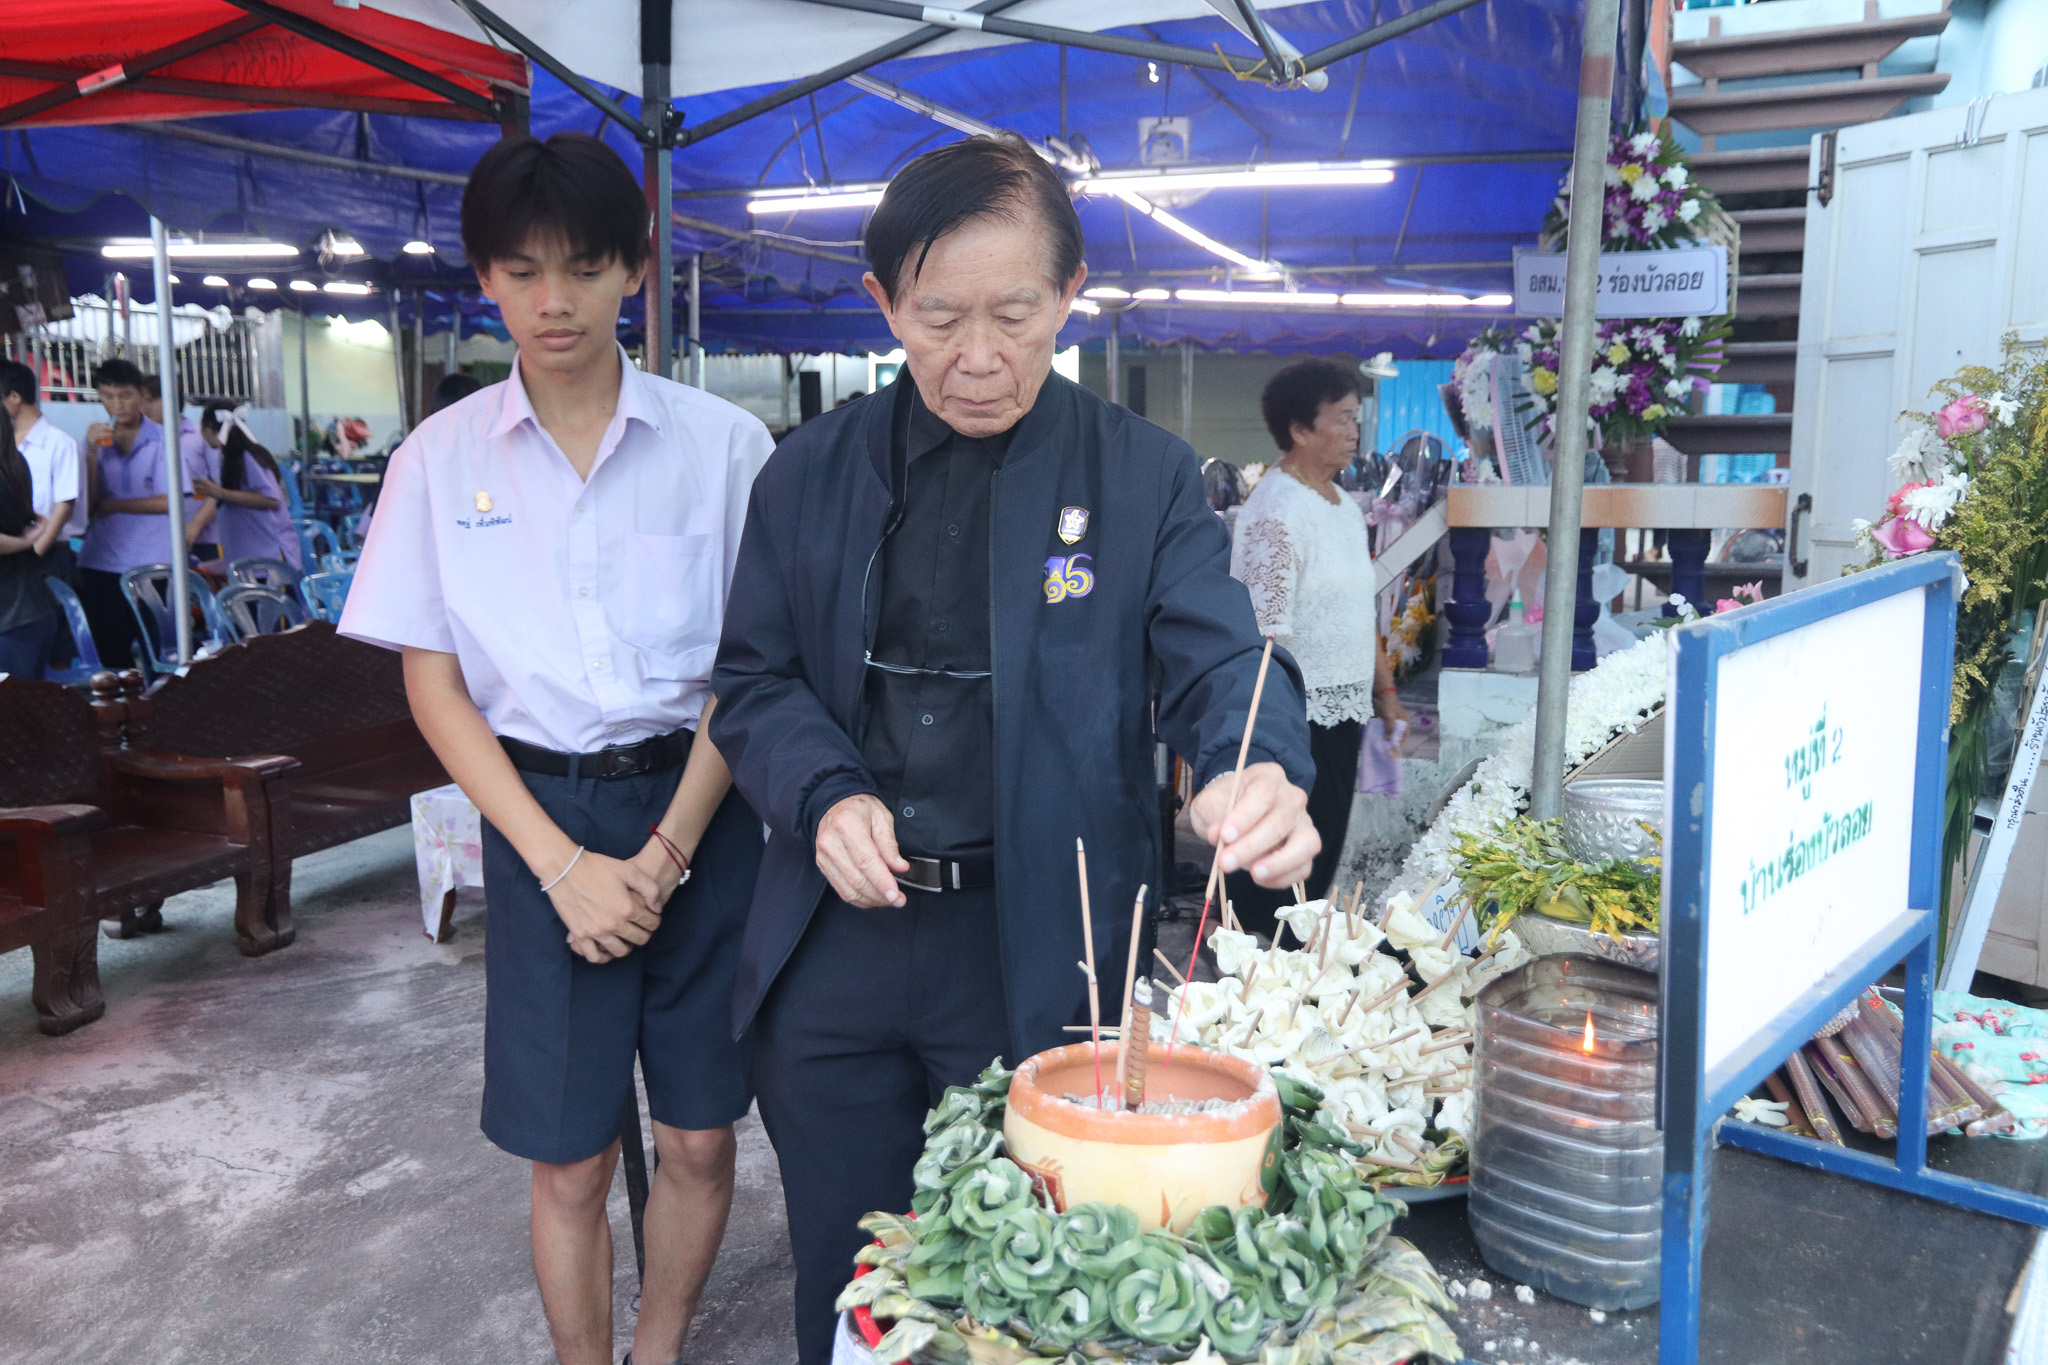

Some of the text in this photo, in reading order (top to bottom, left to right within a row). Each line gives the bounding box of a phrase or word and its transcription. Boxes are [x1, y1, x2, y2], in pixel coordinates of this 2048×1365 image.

[1608, 264, 1704, 294] ร่องบัวลอย
[1784, 701, 1843, 801] หมู่ที่ 2
